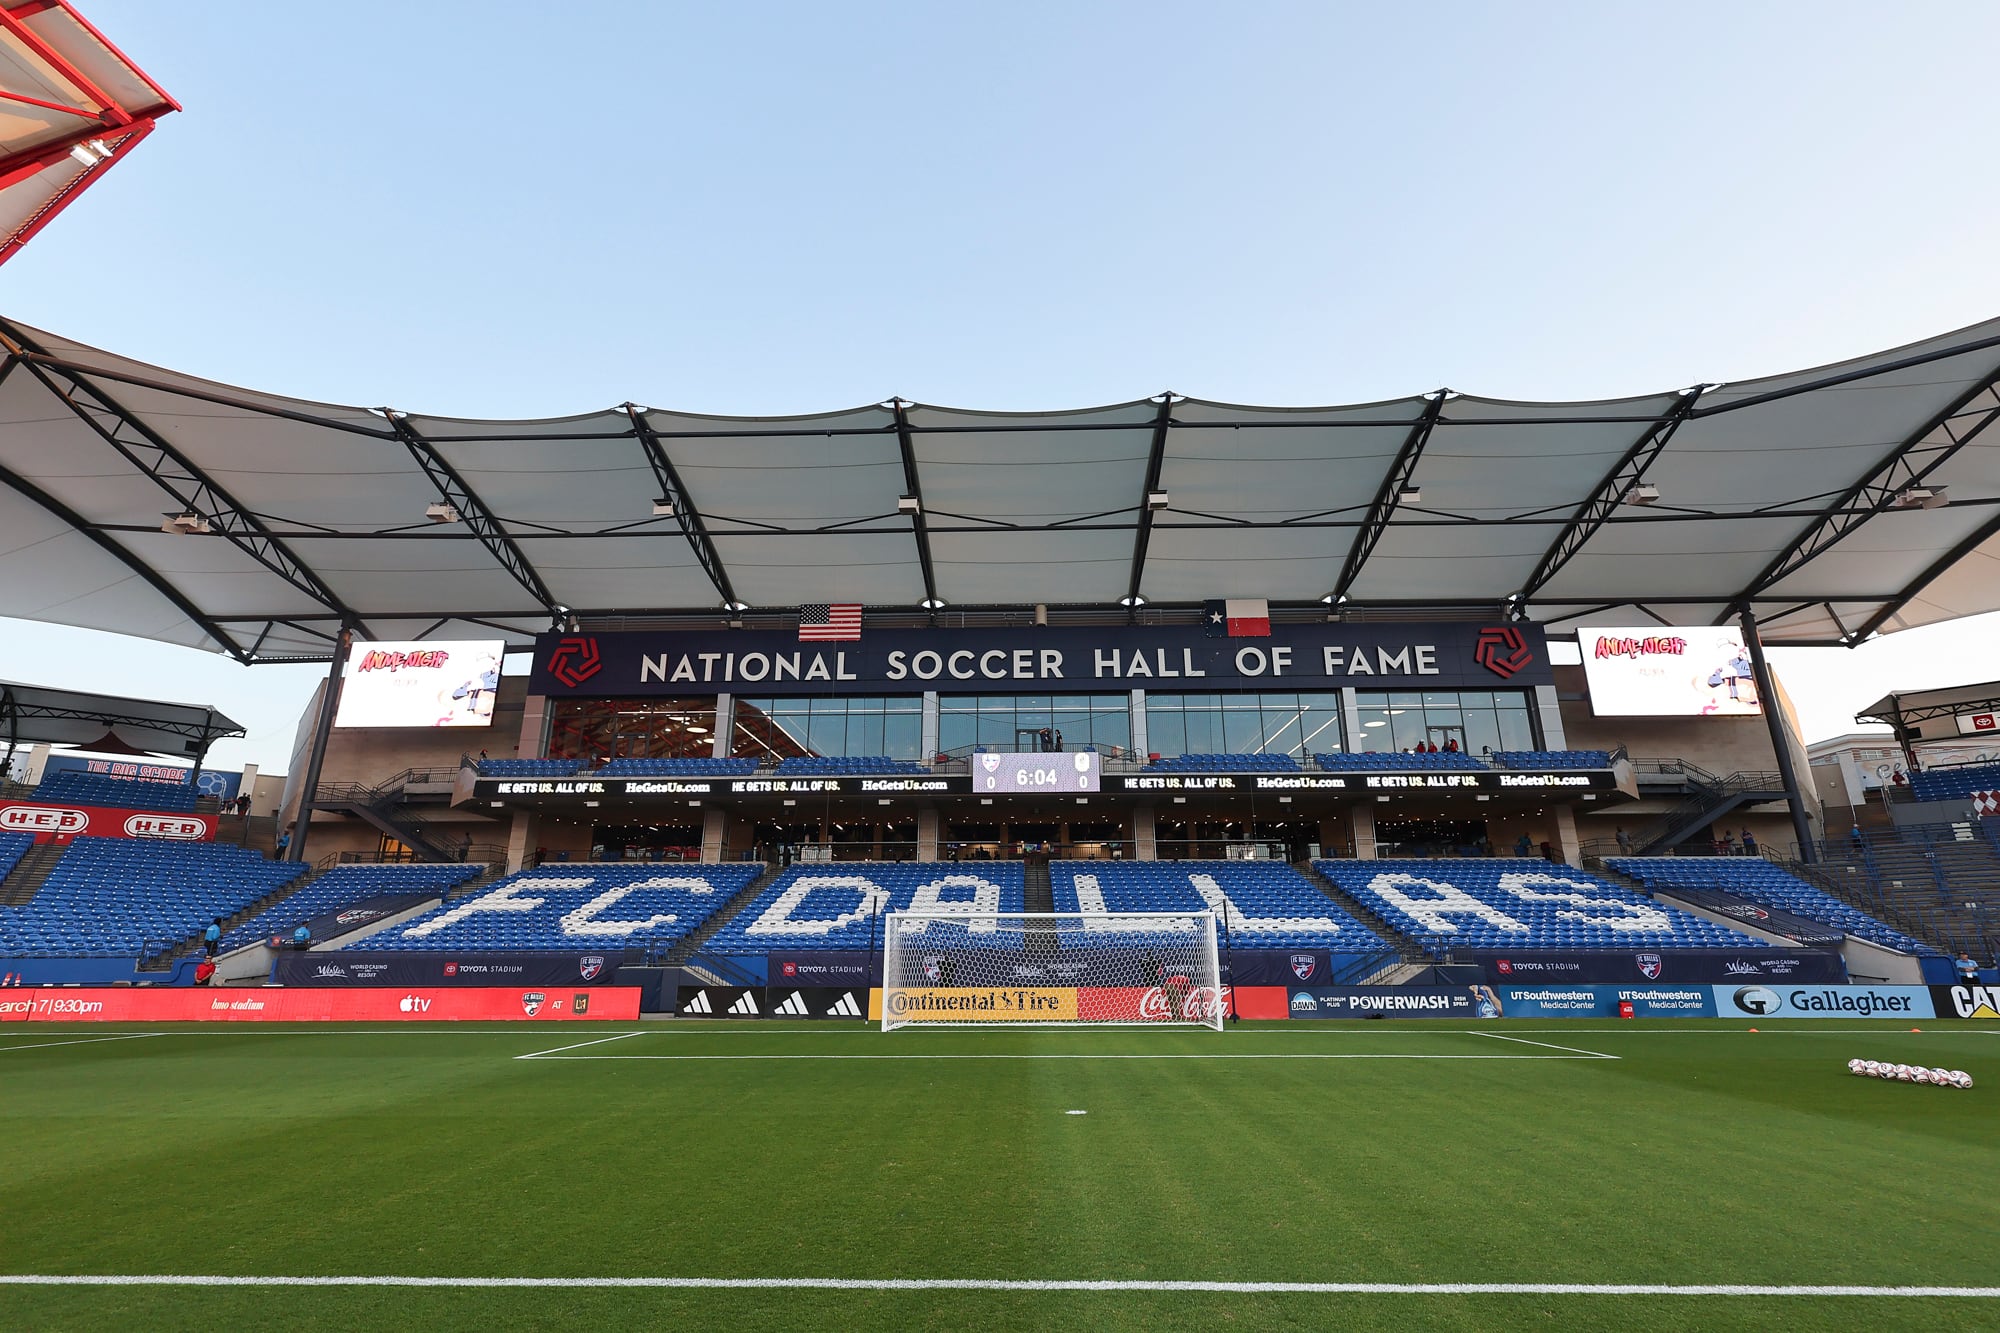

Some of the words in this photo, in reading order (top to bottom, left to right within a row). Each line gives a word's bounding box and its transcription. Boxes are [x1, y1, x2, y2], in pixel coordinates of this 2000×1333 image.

[1595, 636, 1642, 659] ANIME
[1641, 637, 1687, 655] NIGHT
[358, 650, 405, 672] ANIME
[402, 650, 449, 668] NIGHT
[640, 652, 857, 683] NATIONAL
[886, 649, 1064, 680] SOCCER
[1094, 648, 1206, 677] HALL
[1235, 647, 1292, 677] OF
[1323, 645, 1440, 675] FAME
[88, 760, 109, 772] THE
[110, 763, 137, 780] BIG
[138, 766, 187, 784] SCORE
[1017, 769, 1057, 785] 6:04
[732, 781, 745, 791] HE
[747, 781, 773, 791] GETS
[773, 781, 789, 791] US.
[790, 781, 809, 791] ALL
[810, 781, 824, 791] OF
[824, 781, 840, 791] US.
[862, 780, 948, 790] HeGetsUs.com
[987, 777, 995, 789] 0
[1080, 776, 1088, 788] 0
[1125, 778, 1137, 788] HE
[1139, 778, 1165, 788] GETS
[1166, 778, 1182, 788] US.
[1184, 778, 1203, 788] ALL
[1205, 778, 1219, 788] OF
[1219, 778, 1235, 788] US.
[1257, 777, 1345, 788] HeGetsUs.com
[1367, 776, 1380, 787] HE
[1382, 776, 1407, 787] GETS
[1409, 776, 1425, 787] US.
[1427, 776, 1447, 787] ALL
[1448, 776, 1461, 787] OF
[1462, 776, 1479, 787] US.
[1500, 776, 1590, 786] HeGetsUs.com
[498, 783, 511, 793] HE
[513, 783, 538, 793] GETS
[539, 783, 554, 793] US.
[555, 783, 574, 793] ALL
[575, 783, 589, 793] OF
[589, 783, 604, 793] US.
[626, 782, 710, 792] HeGetsUs.com
[211, 998, 230, 1010] bmo
[230, 998, 264, 1010] stadium
[414, 996, 432, 1012] tv
[551, 1001, 563, 1009] AT
[888, 991, 996, 1015] Continental
[1012, 991, 1059, 1010] Tire
[1292, 1001, 1317, 1010] DAWN
[1350, 995, 1450, 1010] POWERWASH
[1540, 1001, 1569, 1009] Medical
[1570, 1001, 1595, 1009] Center
[1649, 1000, 1677, 1008] Medical
[1678, 1001, 1703, 1009] Center
[1790, 990, 1912, 1015] Gallagher
